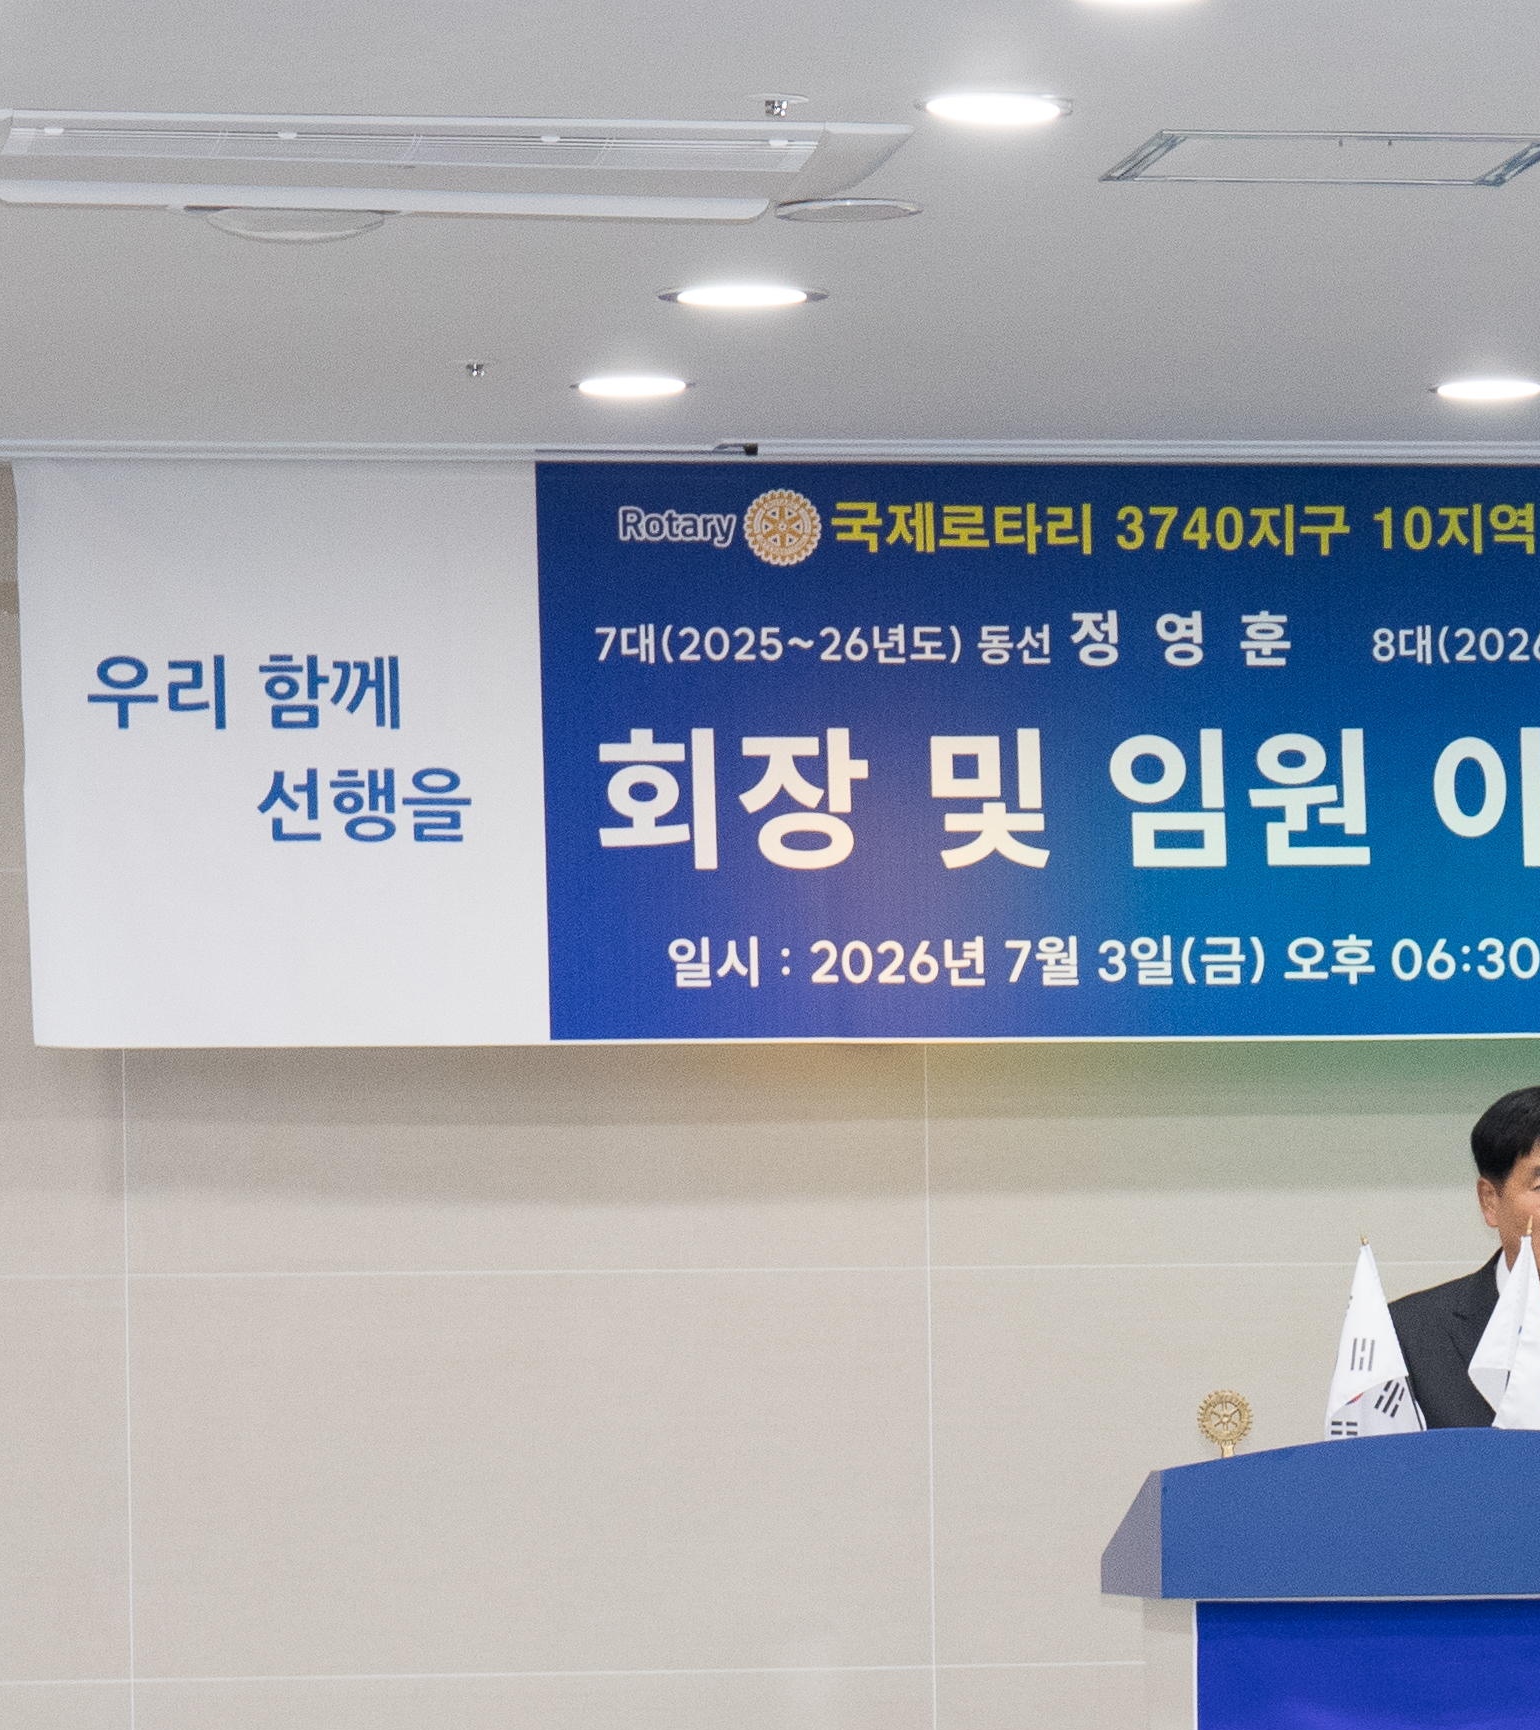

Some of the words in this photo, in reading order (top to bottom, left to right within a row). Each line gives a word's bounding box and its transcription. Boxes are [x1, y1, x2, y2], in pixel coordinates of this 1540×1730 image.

[618, 505, 737, 548] Rotary
[831, 502, 1092, 555] 국제로타리
[1116, 504, 1350, 556] 3740지구
[1374, 503, 1535, 554] 10지역
[595, 623, 961, 664] 7대(2025~26년도)
[977, 624, 1051, 665] 동선
[88, 655, 226, 730] 우리
[259, 654, 400, 729] 함께
[257, 768, 471, 842] 선행을
[599, 728, 869, 870] 회장
[930, 728, 1050, 869] 및
[1109, 729, 1370, 868] 임원
[668, 936, 759, 988] 일시
[811, 936, 985, 986] 2026년
[1005, 935, 1079, 986] 7월
[1098, 935, 1265, 985] 3일(금)
[1284, 934, 1375, 985] 오후
[1391, 937, 1540, 981] 06:30
